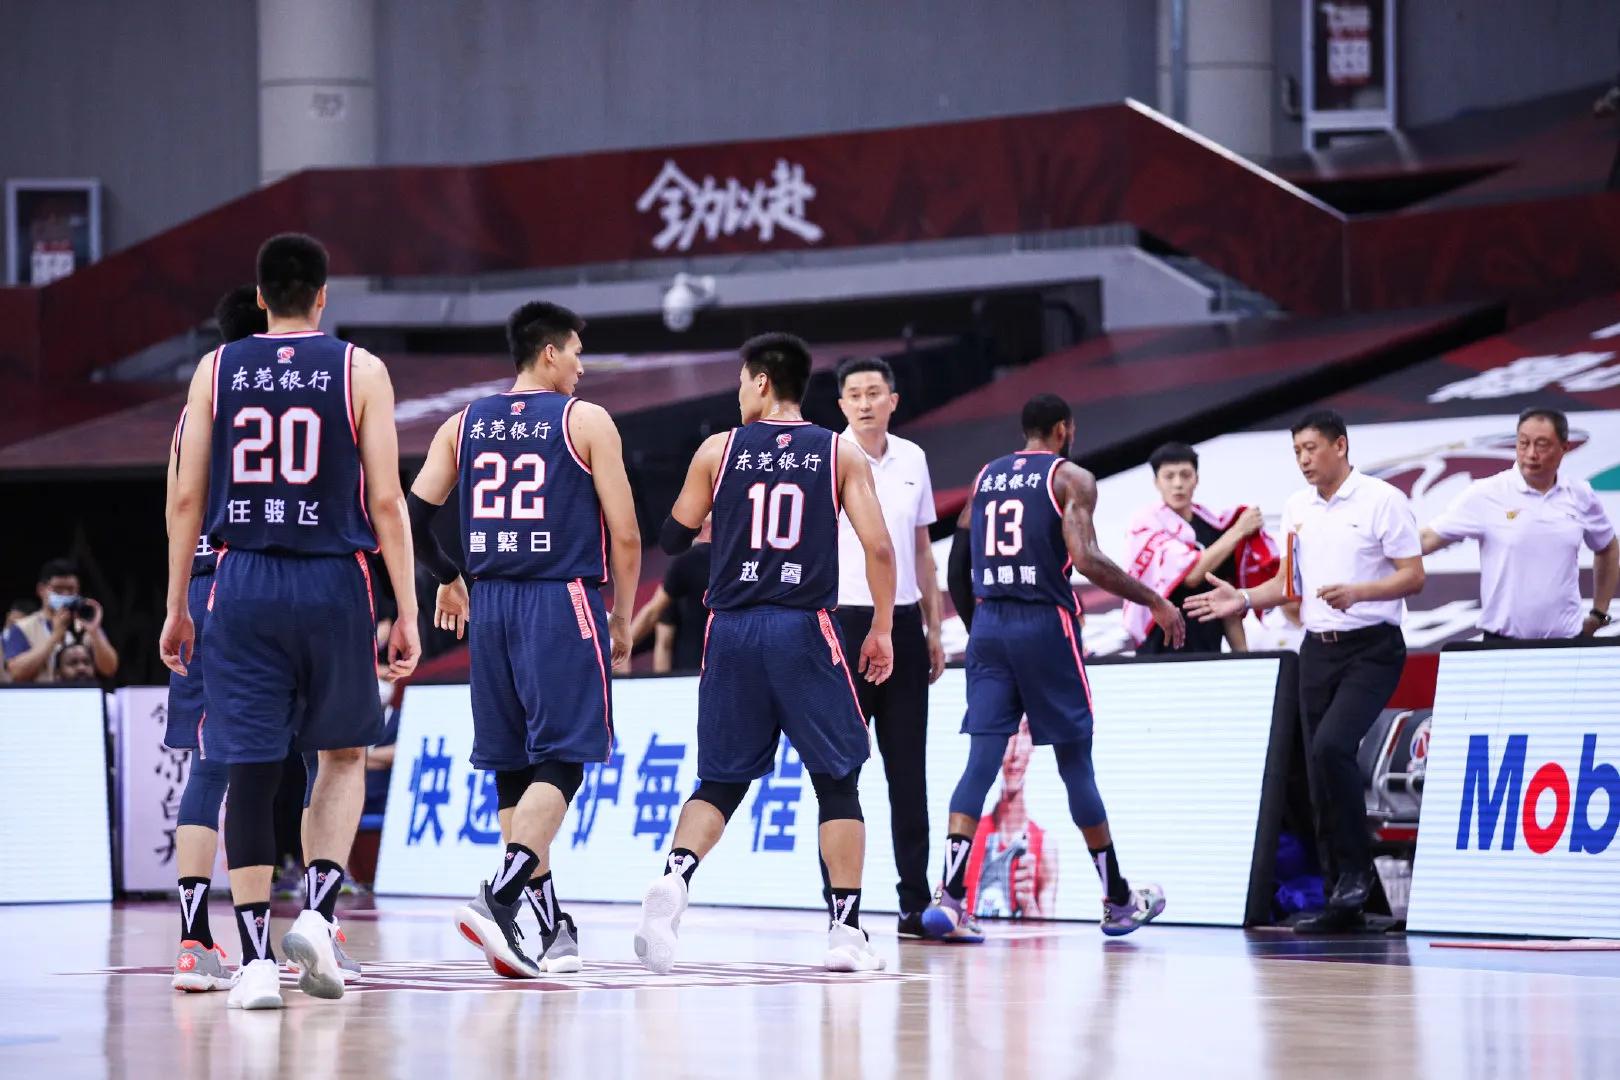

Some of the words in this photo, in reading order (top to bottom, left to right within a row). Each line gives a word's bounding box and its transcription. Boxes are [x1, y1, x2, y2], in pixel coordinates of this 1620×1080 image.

[231, 366, 332, 392] 东莞银行
[469, 418, 552, 441] 东莞银行
[232, 406, 321, 484] 20
[735, 450, 822, 472] 东莞银行
[472, 451, 546, 519] 22
[980, 472, 1041, 492] 东莞银行
[227, 498, 319, 526] 任骏飞
[748, 482, 805, 550] 10
[984, 499, 1024, 556] 13
[469, 531, 551, 553] 曾繁日
[739, 561, 802, 585] 赵睿
[1456, 733, 1620, 855] Mob
